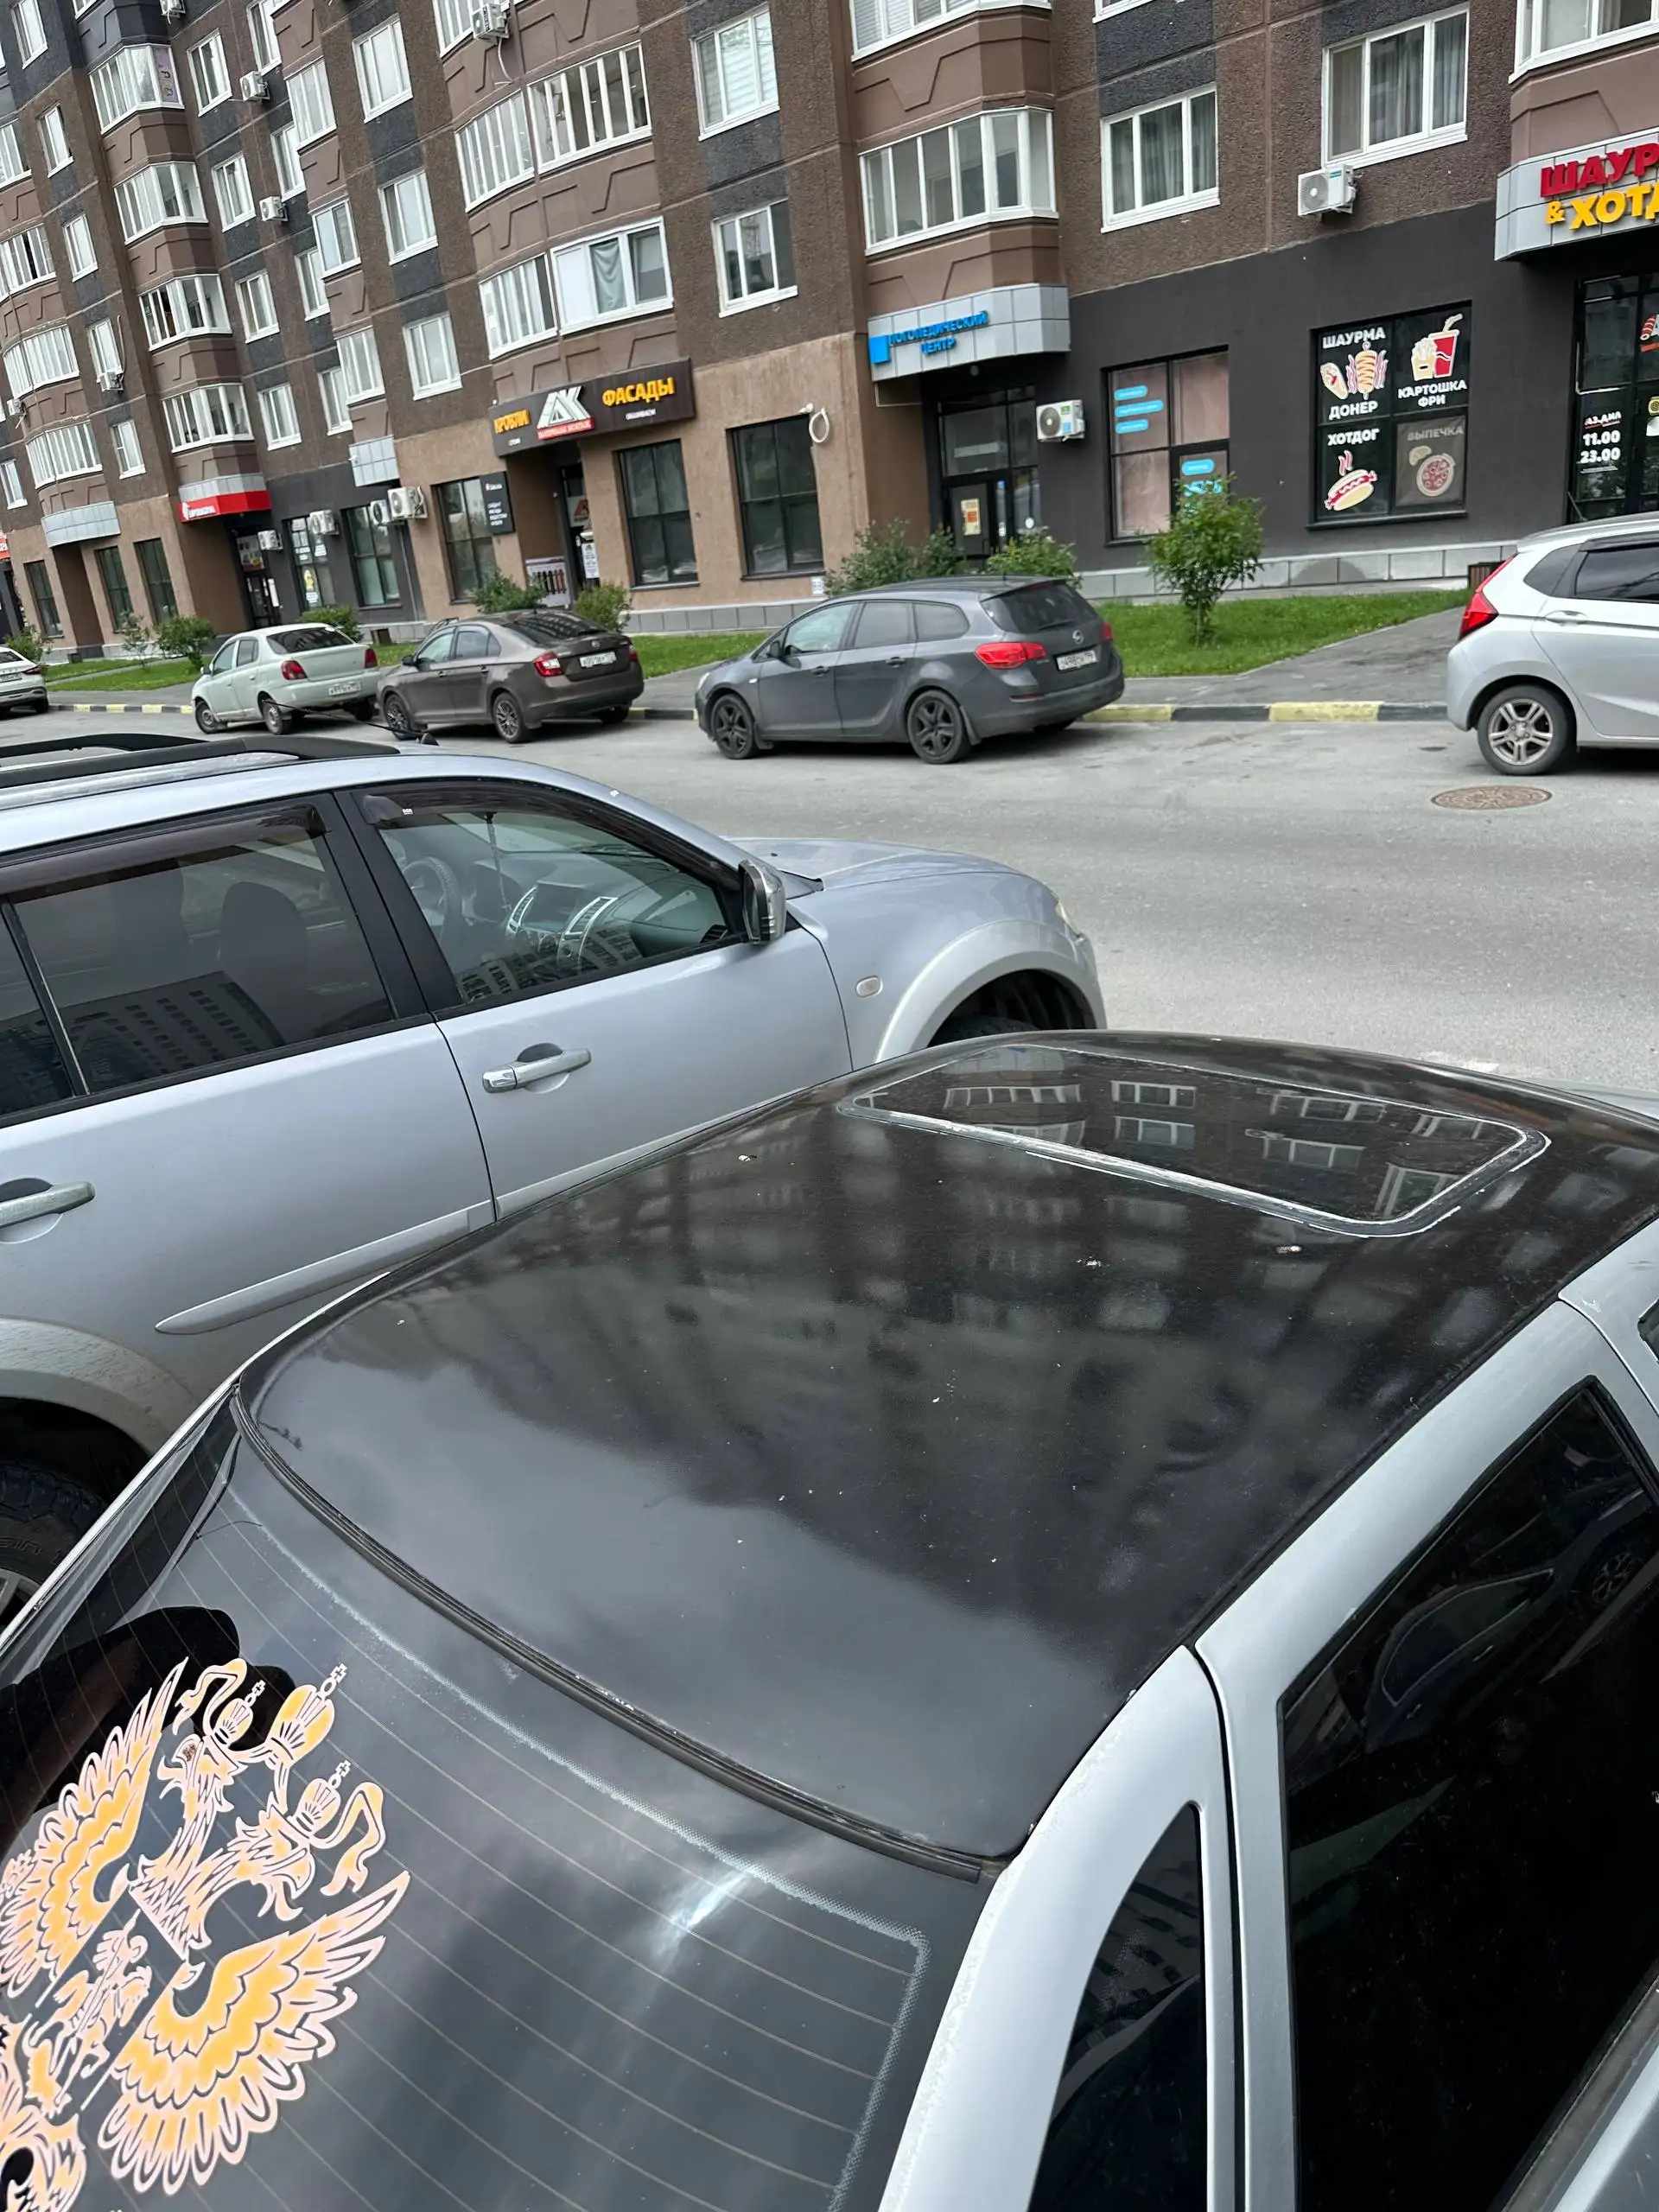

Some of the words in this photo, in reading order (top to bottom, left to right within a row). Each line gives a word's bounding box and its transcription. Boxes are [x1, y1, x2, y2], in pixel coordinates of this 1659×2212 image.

[1541, 143, 1659, 198] ШАУР
[1545, 200, 1566, 225] &
[920, 336, 957, 355] ЦЕНТР
[1322, 327, 1386, 349] ШАУРМА
[602, 377, 675, 407] ФАСАДЫ
[1397, 379, 1467, 398] КАРТОШКА
[1417, 394, 1446, 407] ФРИ
[1329, 401, 1378, 420] ДОНЕР
[1327, 428, 1380, 446] ХОТДОГ
[1408, 426, 1464, 442] ВЫПЕЧКА
[1582, 429, 1621, 446] 11.00
[1580, 447, 1621, 464] 23.00
